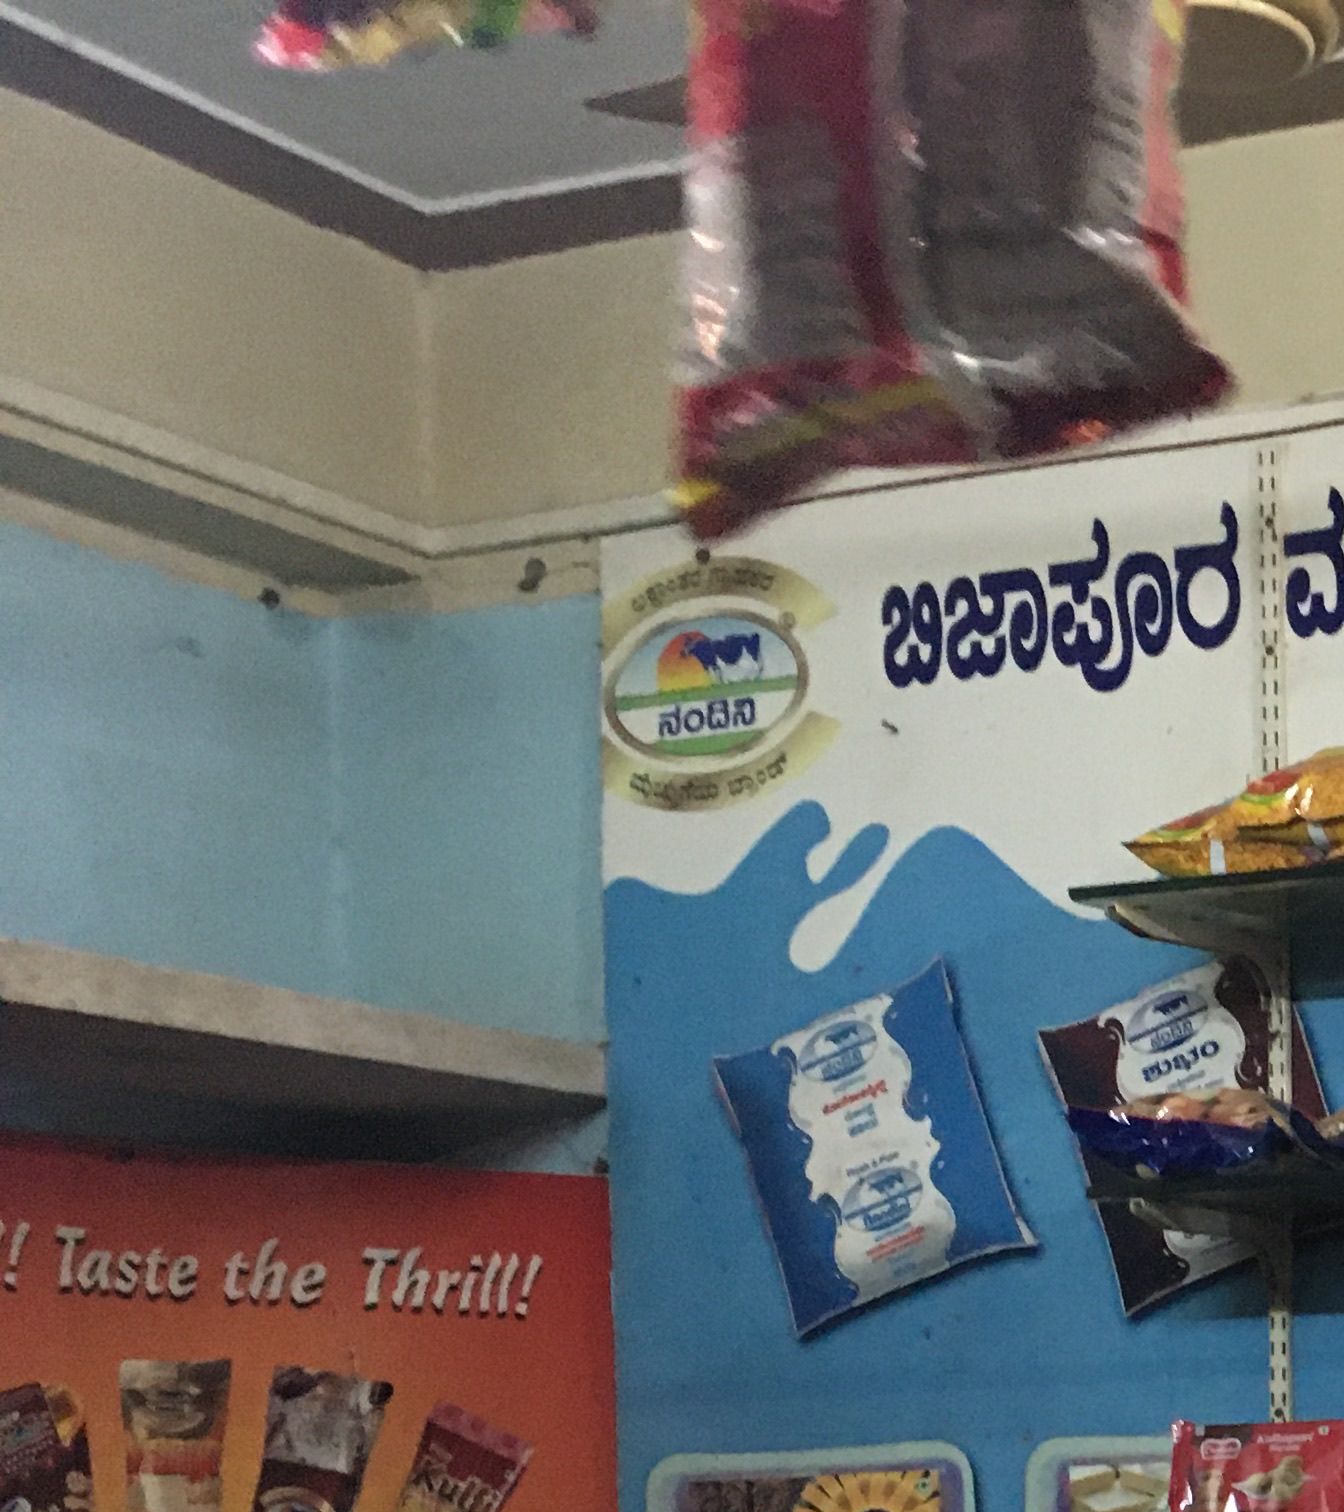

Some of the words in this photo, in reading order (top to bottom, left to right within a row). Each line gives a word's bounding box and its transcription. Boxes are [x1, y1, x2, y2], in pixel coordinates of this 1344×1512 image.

[658, 696, 756, 737] ನಂದಿನಿ
[55, 1223, 199, 1299] Taste
[222, 1237, 328, 1306] the
[361, 1246, 543, 1319] Thrill!
